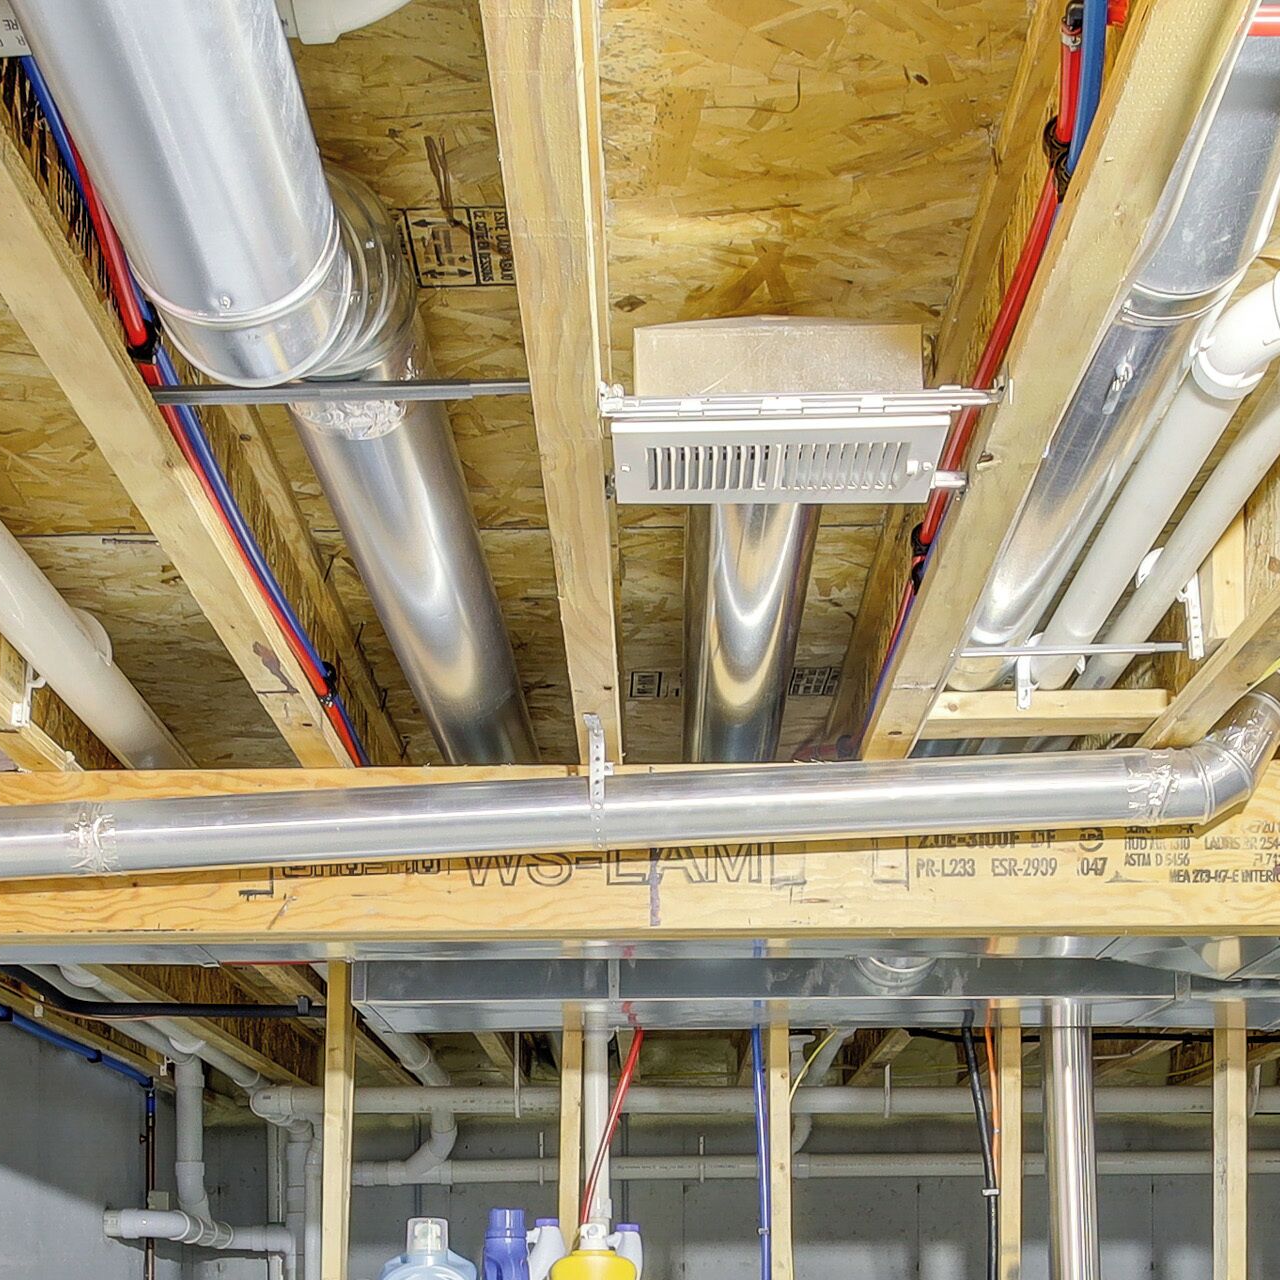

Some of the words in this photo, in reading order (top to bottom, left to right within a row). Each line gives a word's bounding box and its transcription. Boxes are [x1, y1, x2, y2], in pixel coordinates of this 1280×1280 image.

[1124, 837, 1147, 850] HUD
[466, 843, 764, 887] WS-LAM
[917, 858, 976, 878] PR-L233
[1124, 853, 1151, 867] ASTM
[1155, 853, 1163, 867] D
